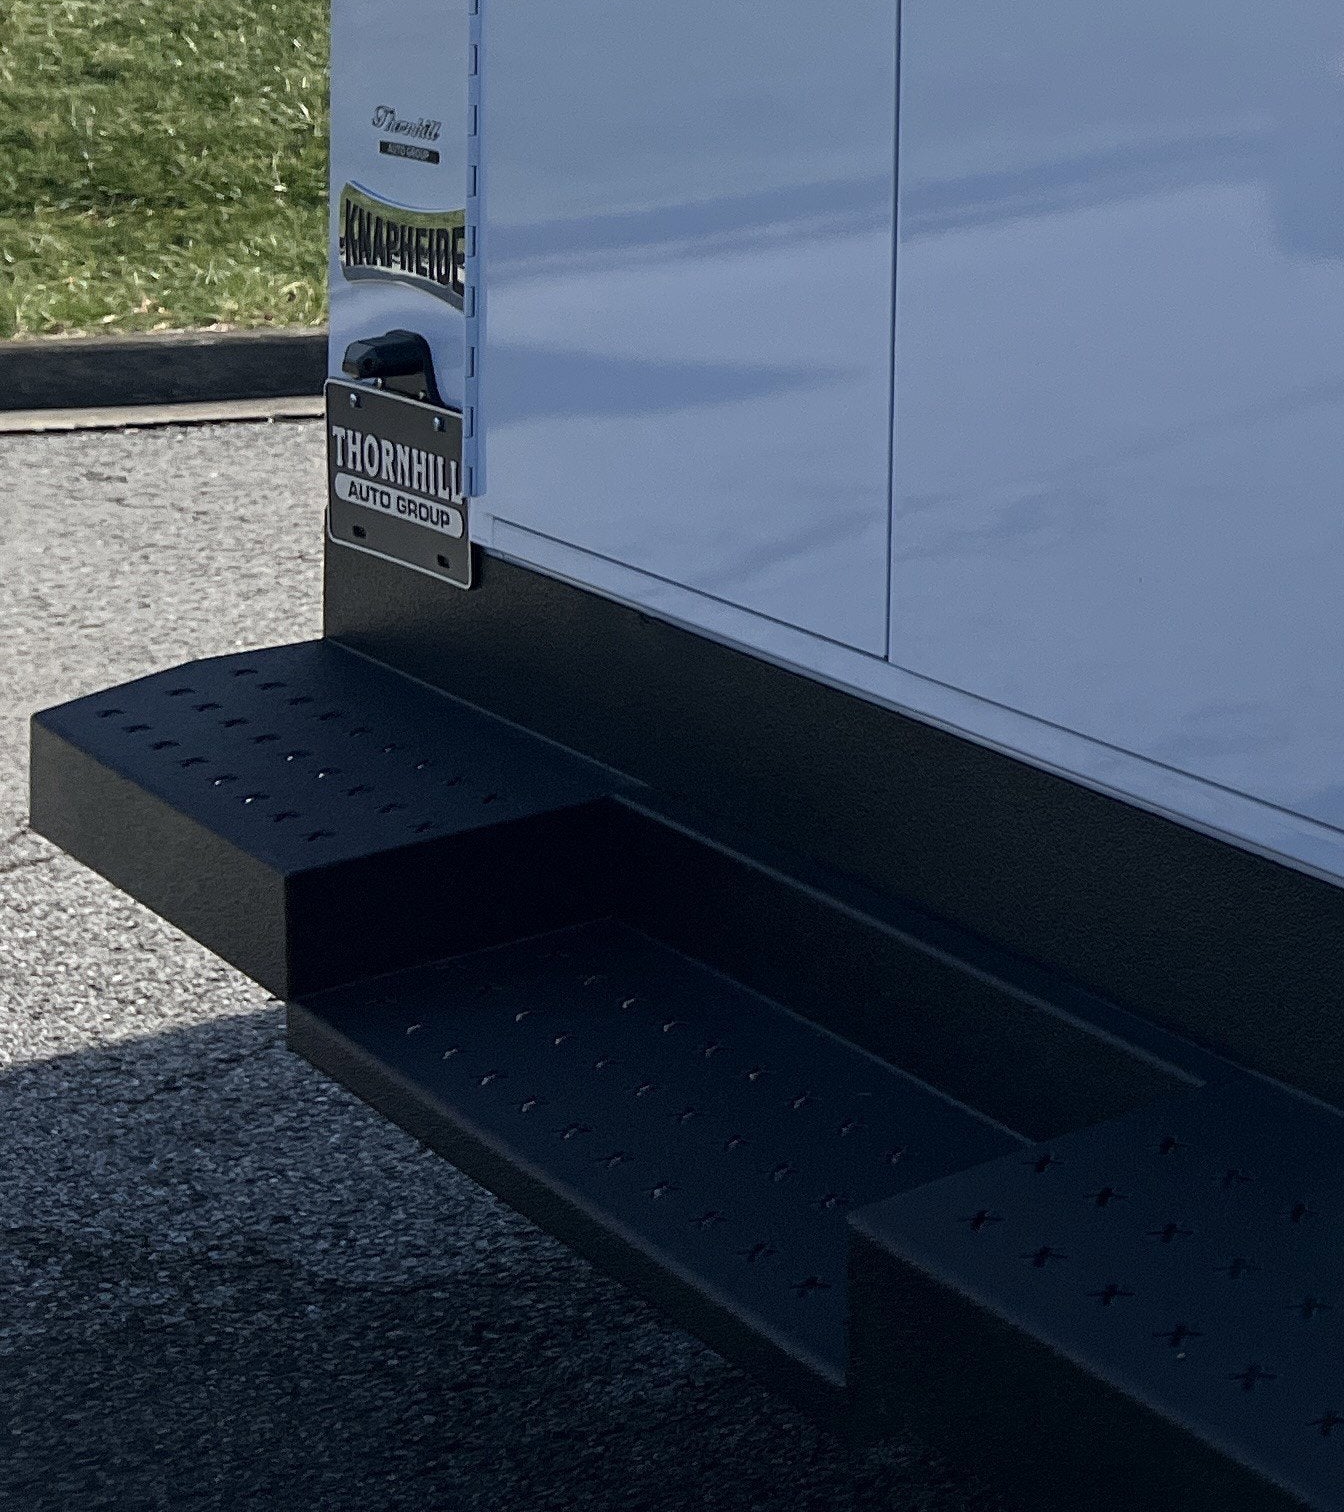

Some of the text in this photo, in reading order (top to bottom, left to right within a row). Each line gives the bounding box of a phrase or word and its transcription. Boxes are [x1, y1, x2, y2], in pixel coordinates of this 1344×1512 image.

[343, 199, 465, 296] KNAPHEIDE
[332, 426, 463, 503] THORNHILL
[347, 479, 451, 529] AUTO GROUP
